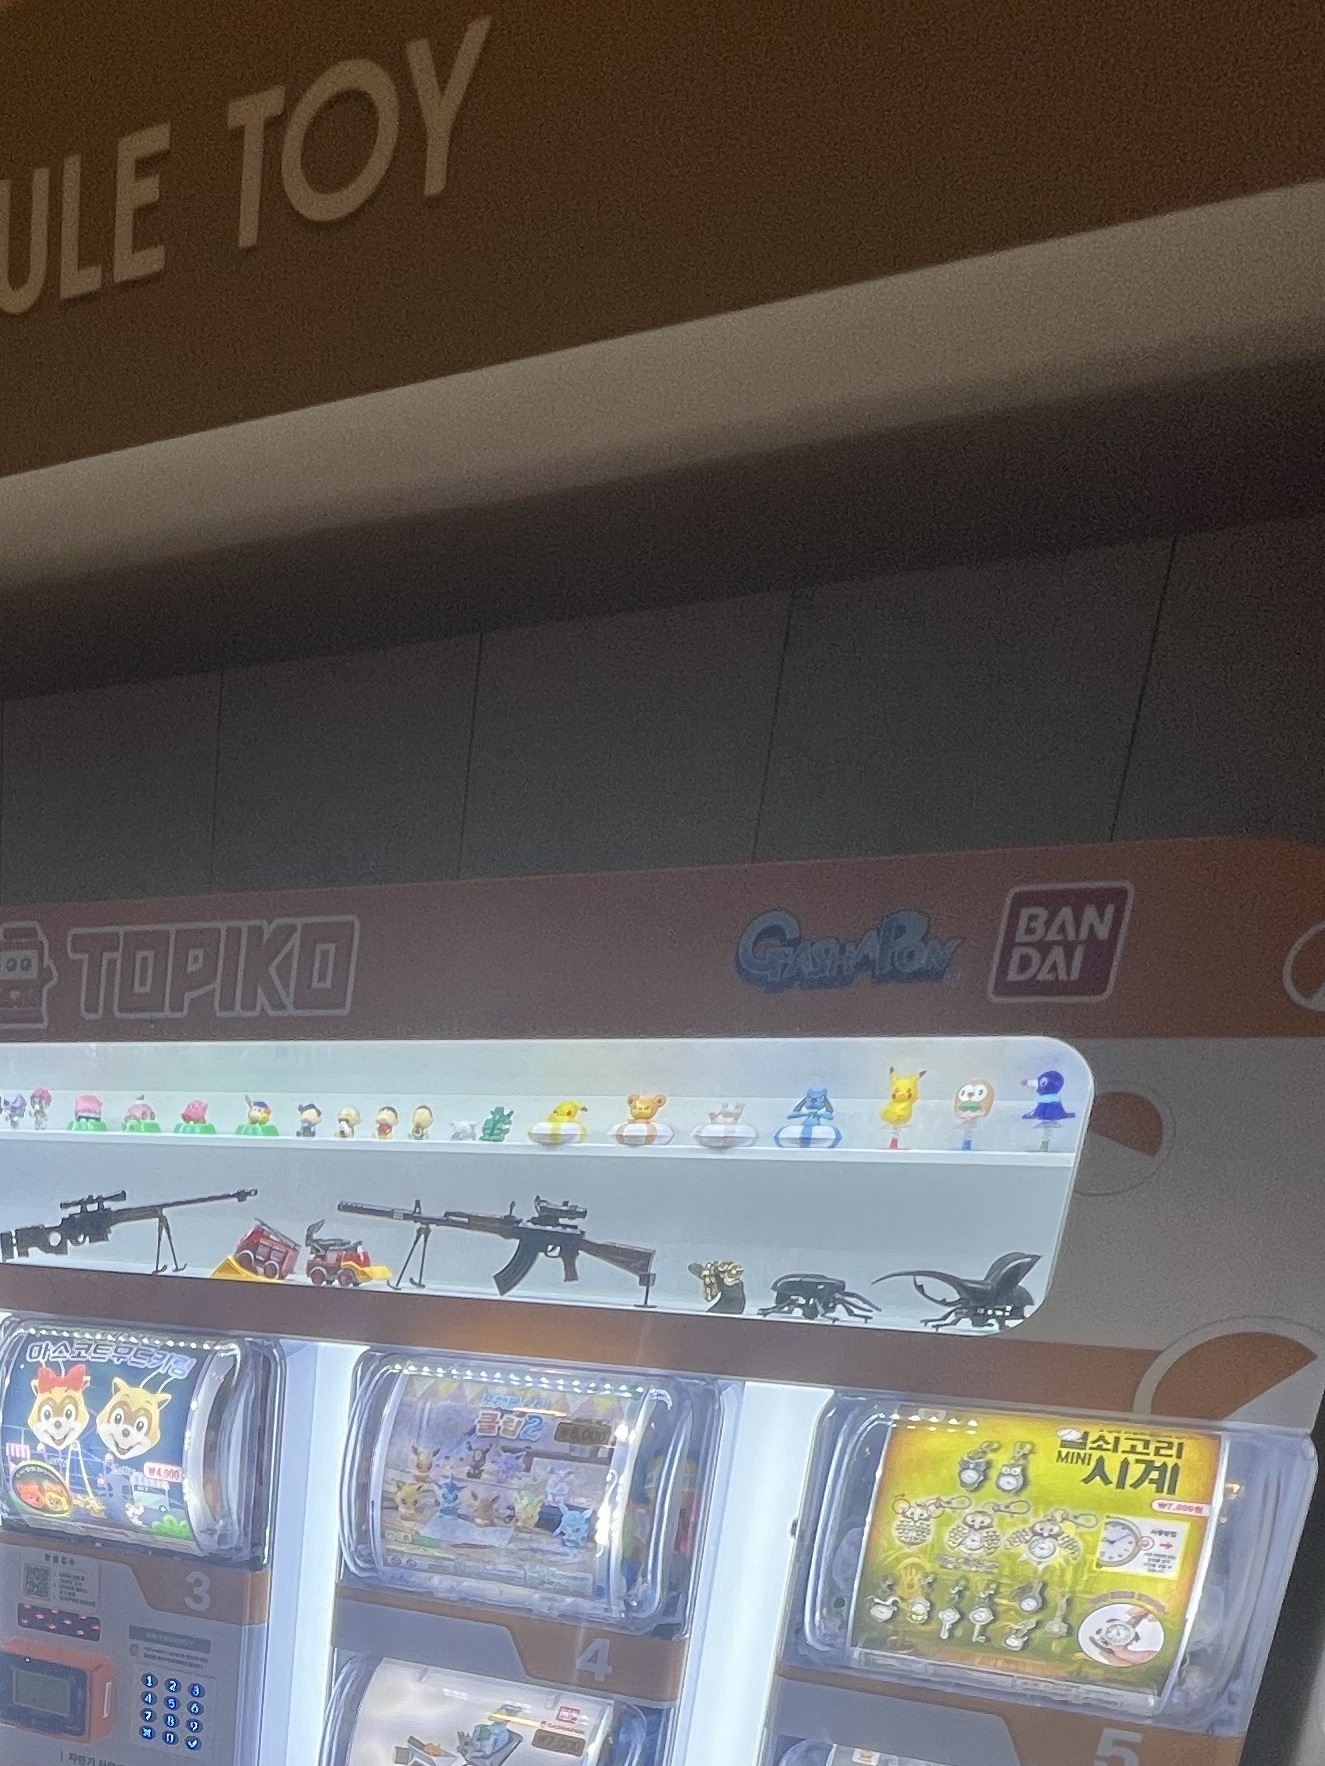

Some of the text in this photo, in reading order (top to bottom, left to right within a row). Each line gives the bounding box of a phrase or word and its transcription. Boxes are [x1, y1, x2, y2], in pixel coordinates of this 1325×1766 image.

[228, 15, 493, 250] TOY
[1014, 905, 1116, 943] BAN
[67, 915, 360, 1020] TOPIKO
[1008, 944, 1085, 983] DAI
[1056, 1450, 1181, 1495] MINI 시계
[184, 1571, 211, 1611] 3
[576, 1638, 613, 1682] 4
